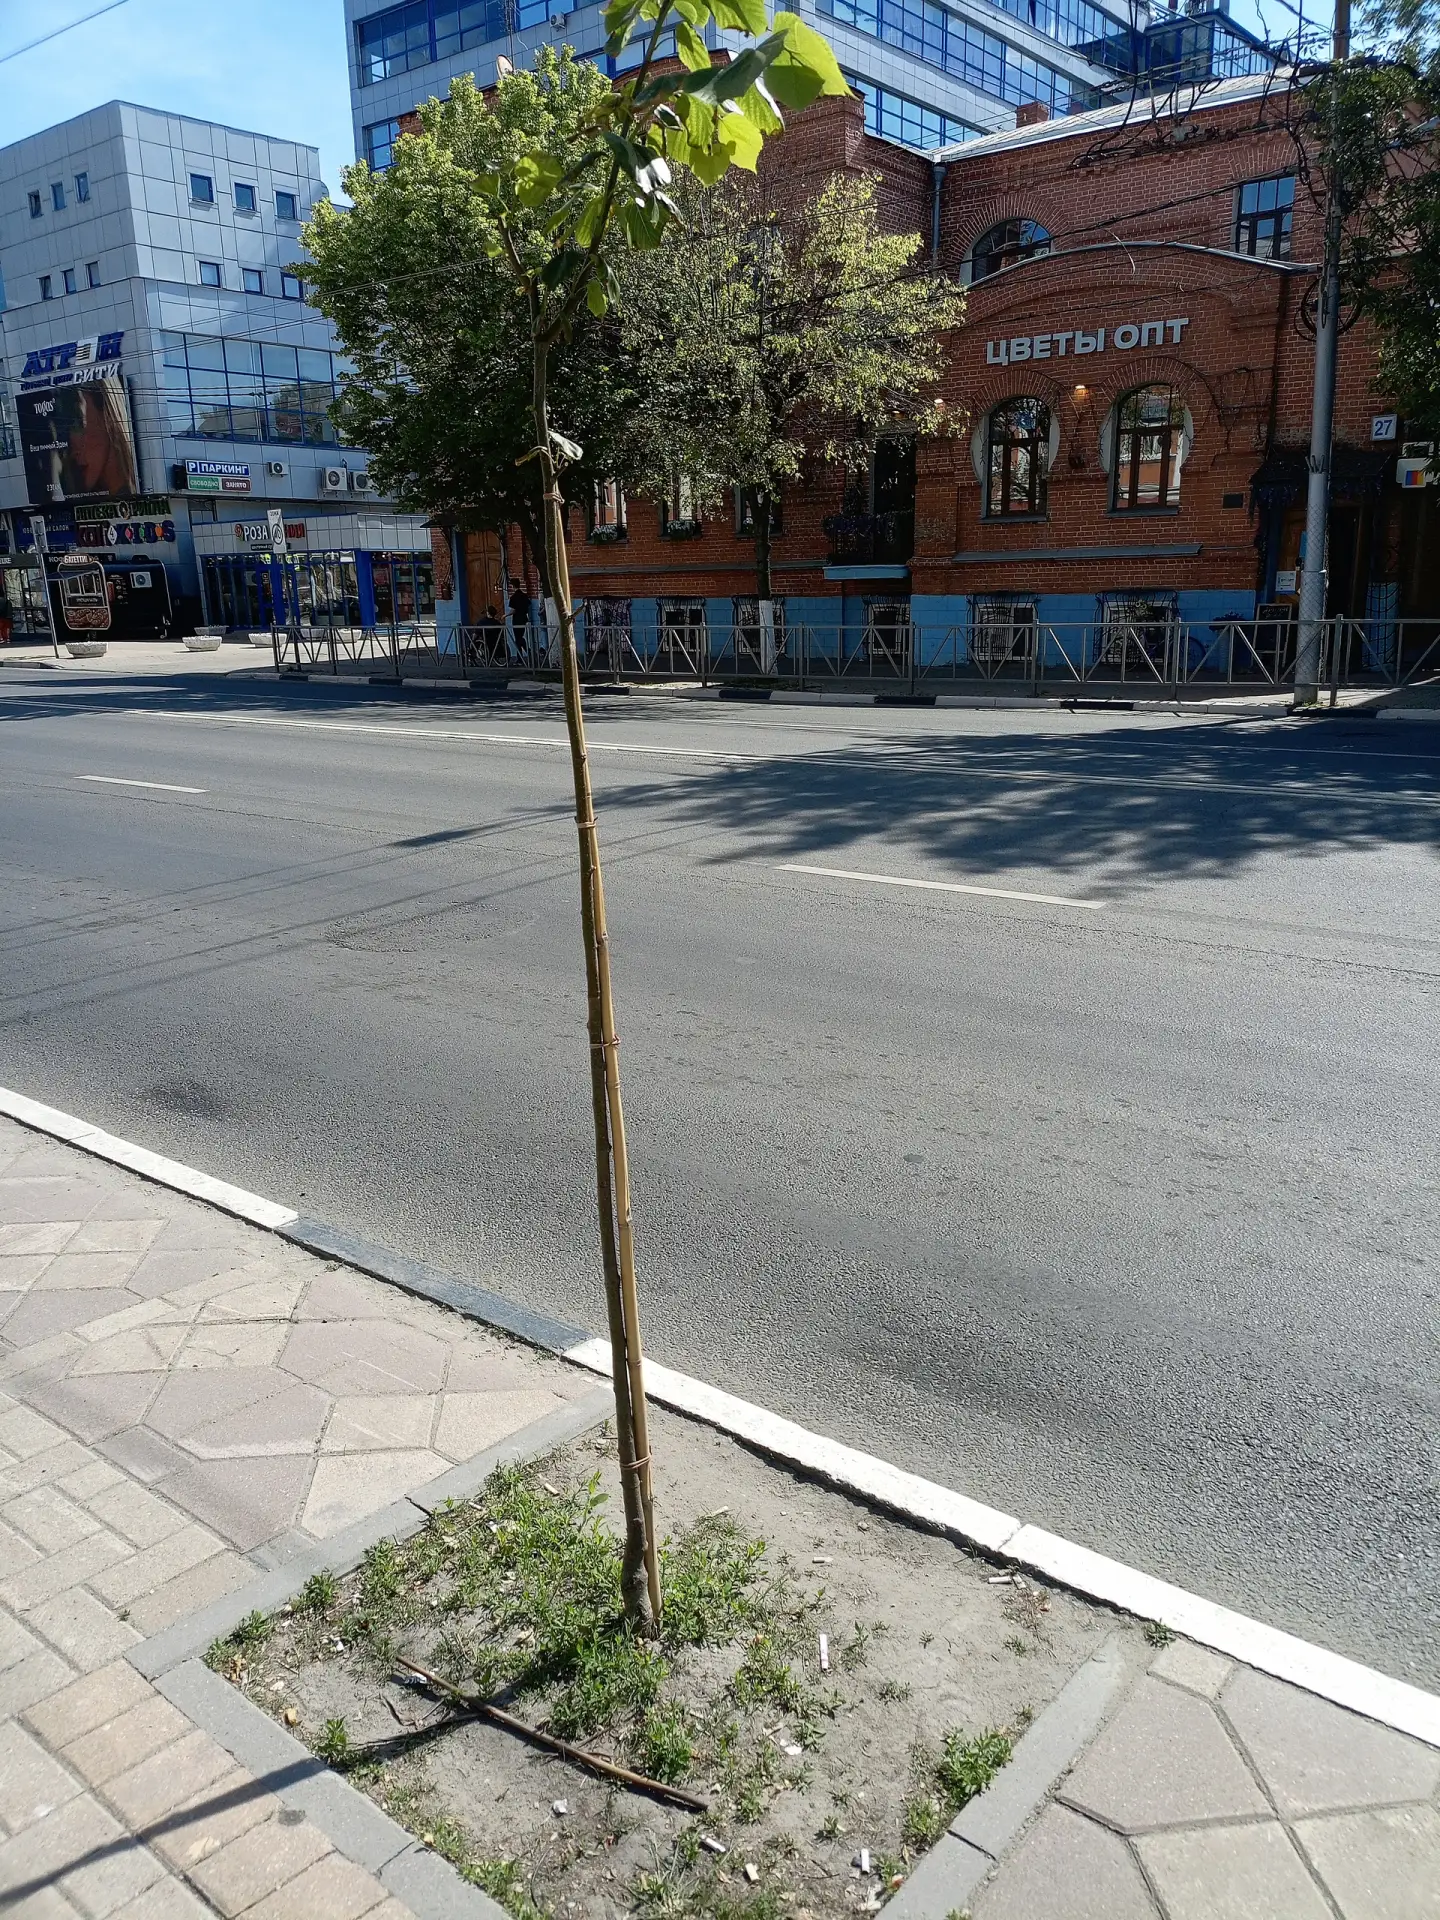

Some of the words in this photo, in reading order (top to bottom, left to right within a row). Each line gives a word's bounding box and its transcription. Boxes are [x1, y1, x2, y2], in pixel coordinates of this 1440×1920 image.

[986, 328, 1105, 366] ЦВЕТЫ
[1113, 318, 1189, 350] ОПТ
[73, 362, 120, 384] СИТИ
[1374, 420, 1393, 436] 27
[201, 463, 248, 474] ПАРКИНГ
[190, 479, 219, 488] СВОБОДНО
[225, 481, 247, 489] ЗАНЯТО
